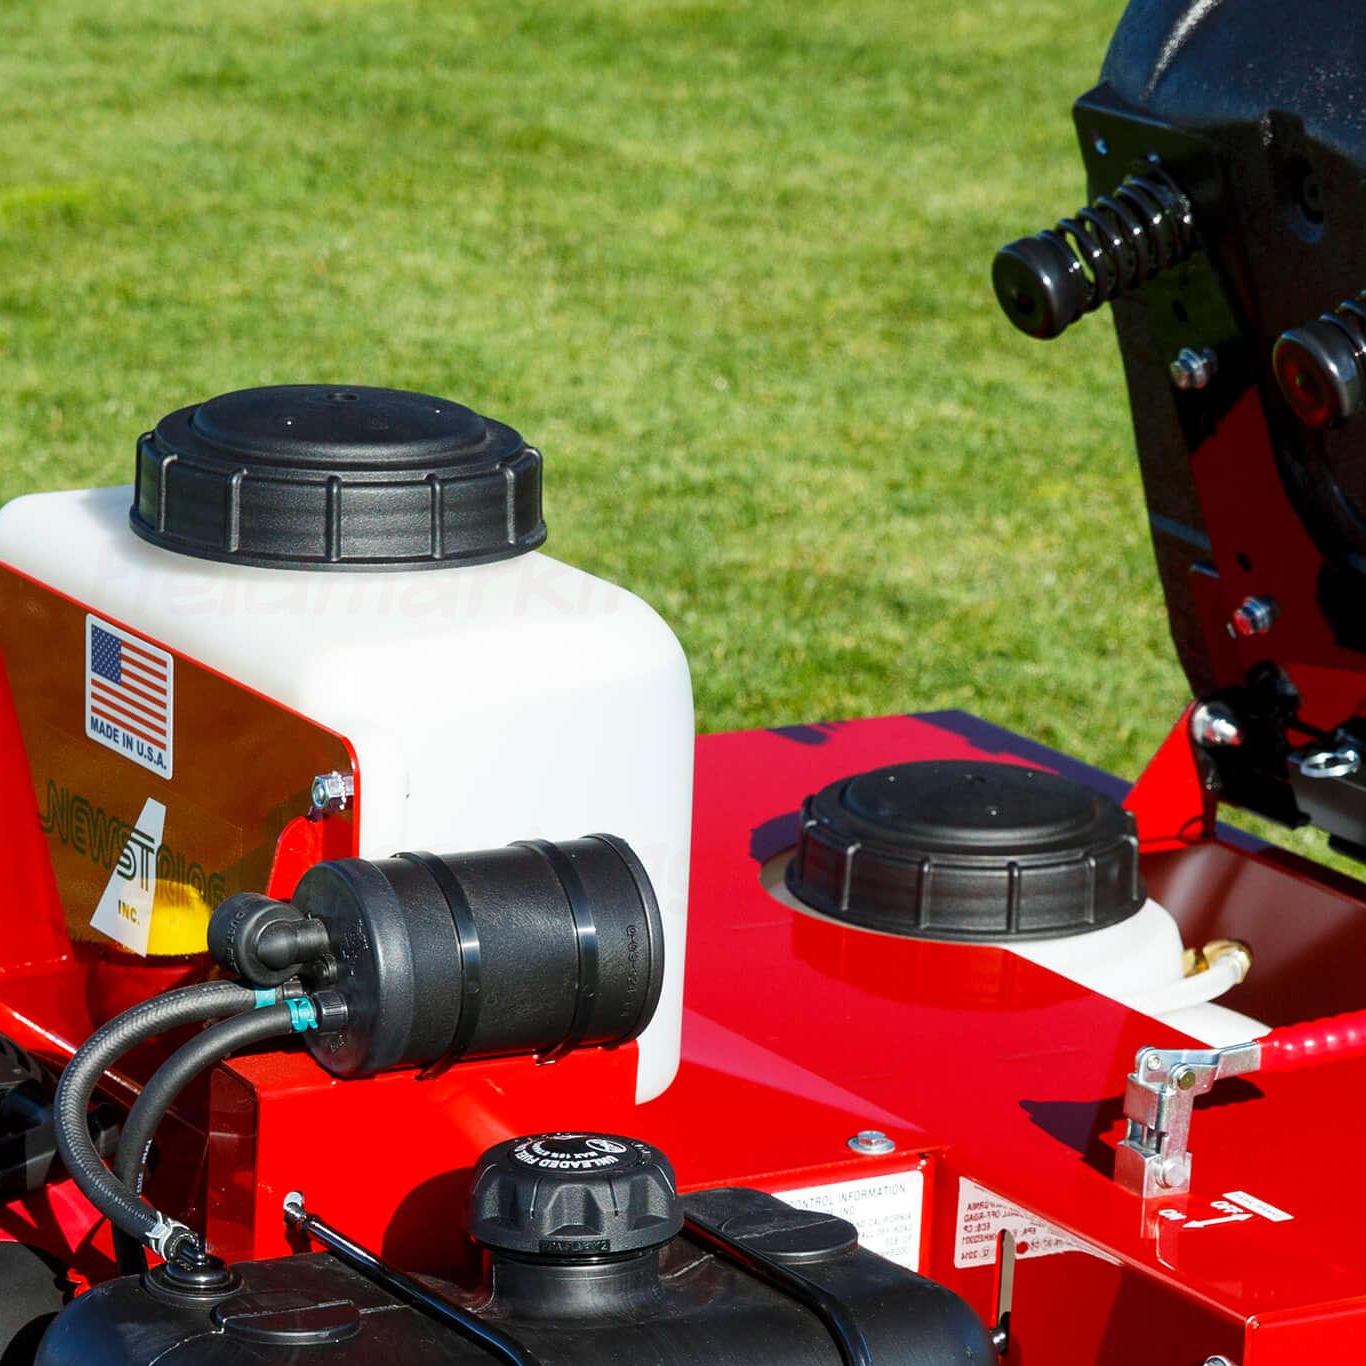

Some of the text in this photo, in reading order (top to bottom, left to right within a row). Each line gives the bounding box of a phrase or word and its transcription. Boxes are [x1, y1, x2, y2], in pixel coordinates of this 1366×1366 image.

[91, 716, 166, 770] MADE IN U.S.A.
[118, 900, 140, 925] INC.
[538, 1154, 620, 1169] UNLEADED
[838, 1184, 906, 1202] INFORMATION
